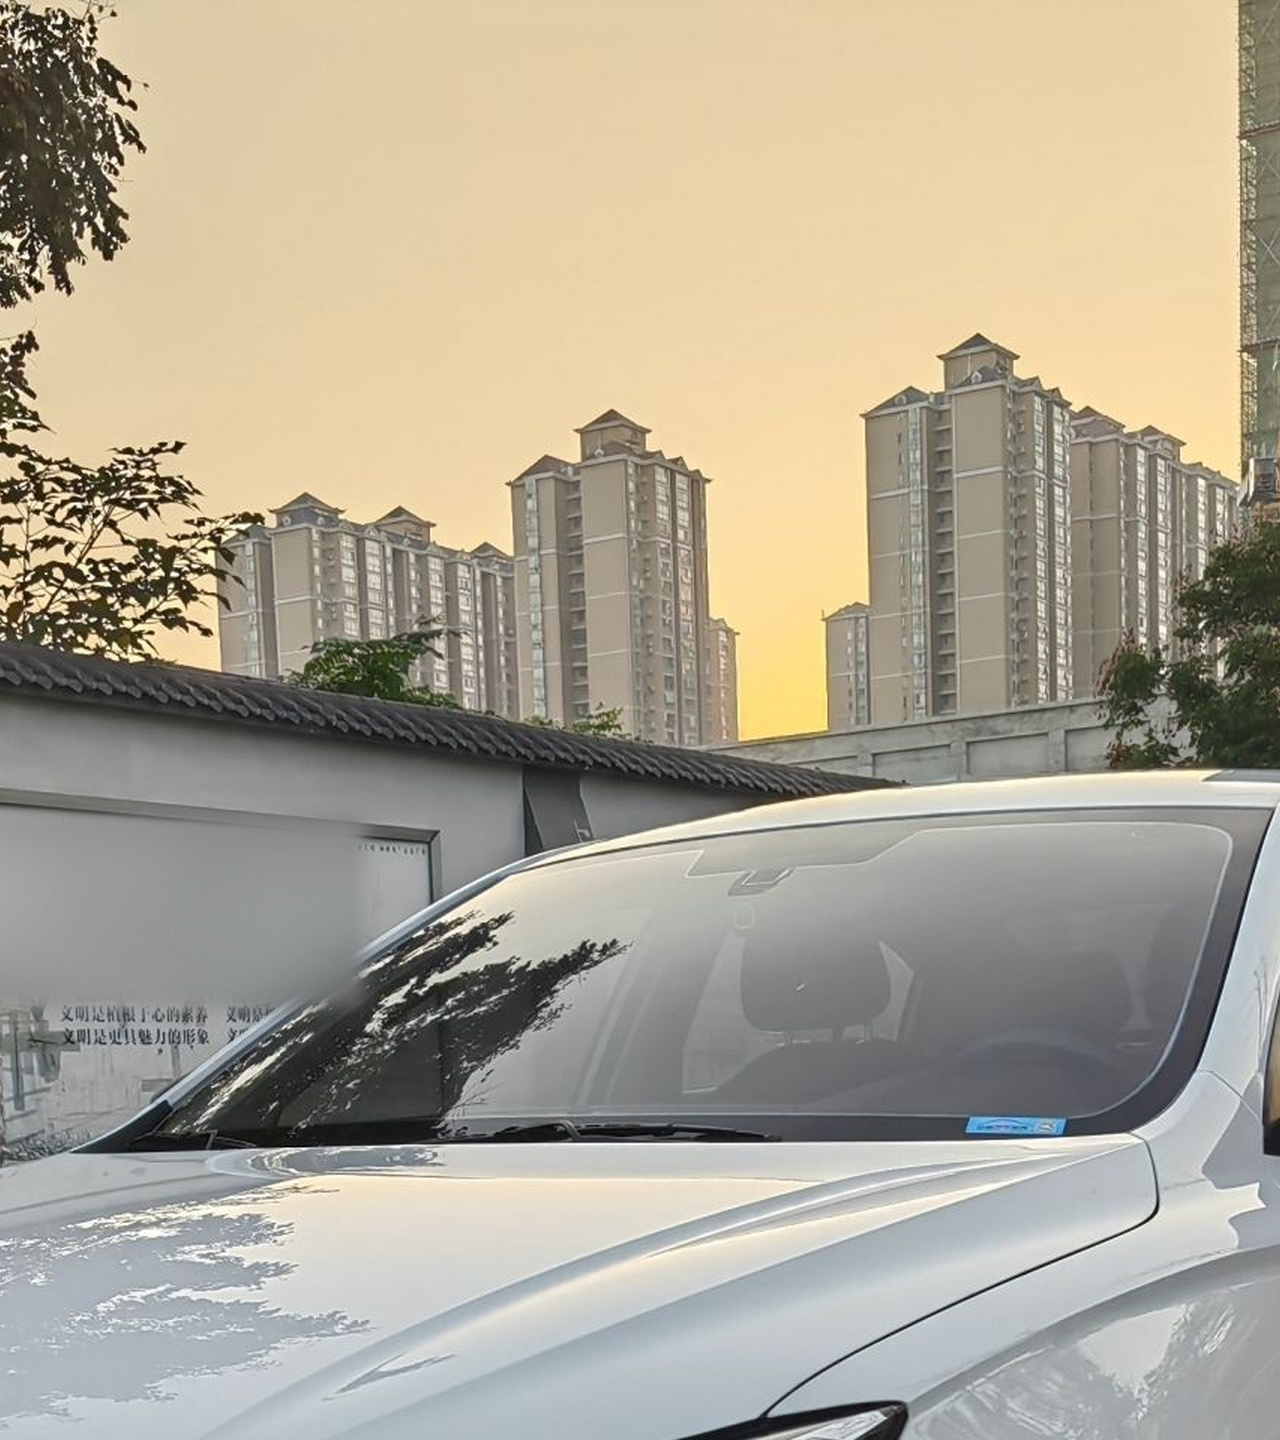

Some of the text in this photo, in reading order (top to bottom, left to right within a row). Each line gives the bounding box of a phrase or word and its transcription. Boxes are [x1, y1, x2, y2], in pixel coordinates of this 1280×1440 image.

[61, 1005, 208, 1023] 文明是植根于心的素养
[63, 1028, 210, 1045] 文明是更具魅力的形象
